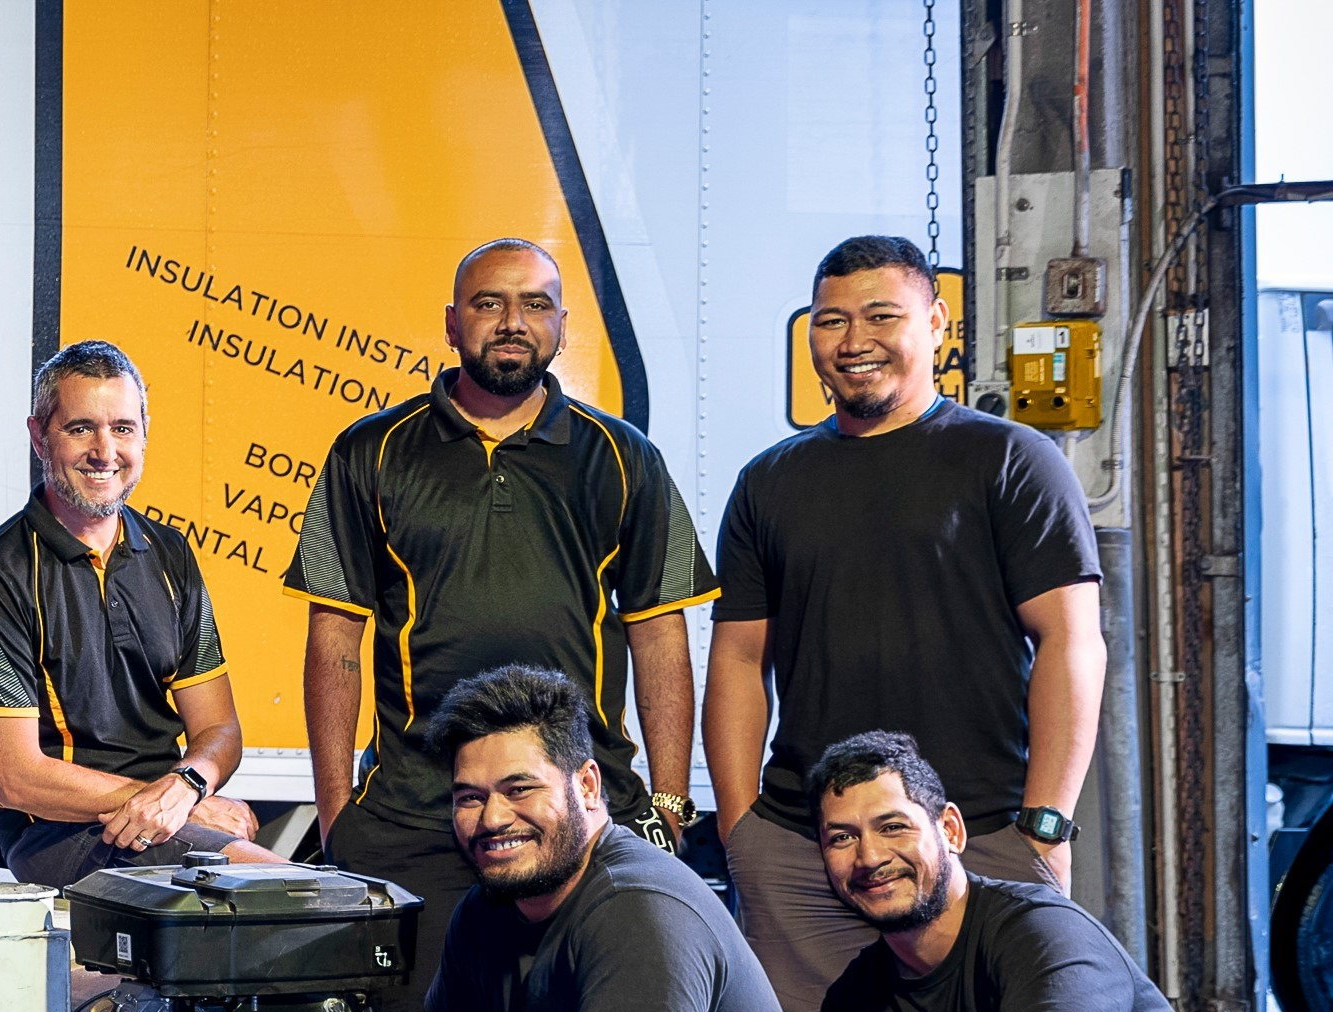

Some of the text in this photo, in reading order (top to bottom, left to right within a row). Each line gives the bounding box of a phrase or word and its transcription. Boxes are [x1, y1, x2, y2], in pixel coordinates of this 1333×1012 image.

[126, 245, 328, 341] INSULATION
[187, 320, 391, 412] INSULATION
[244, 442, 316, 488] BOR
